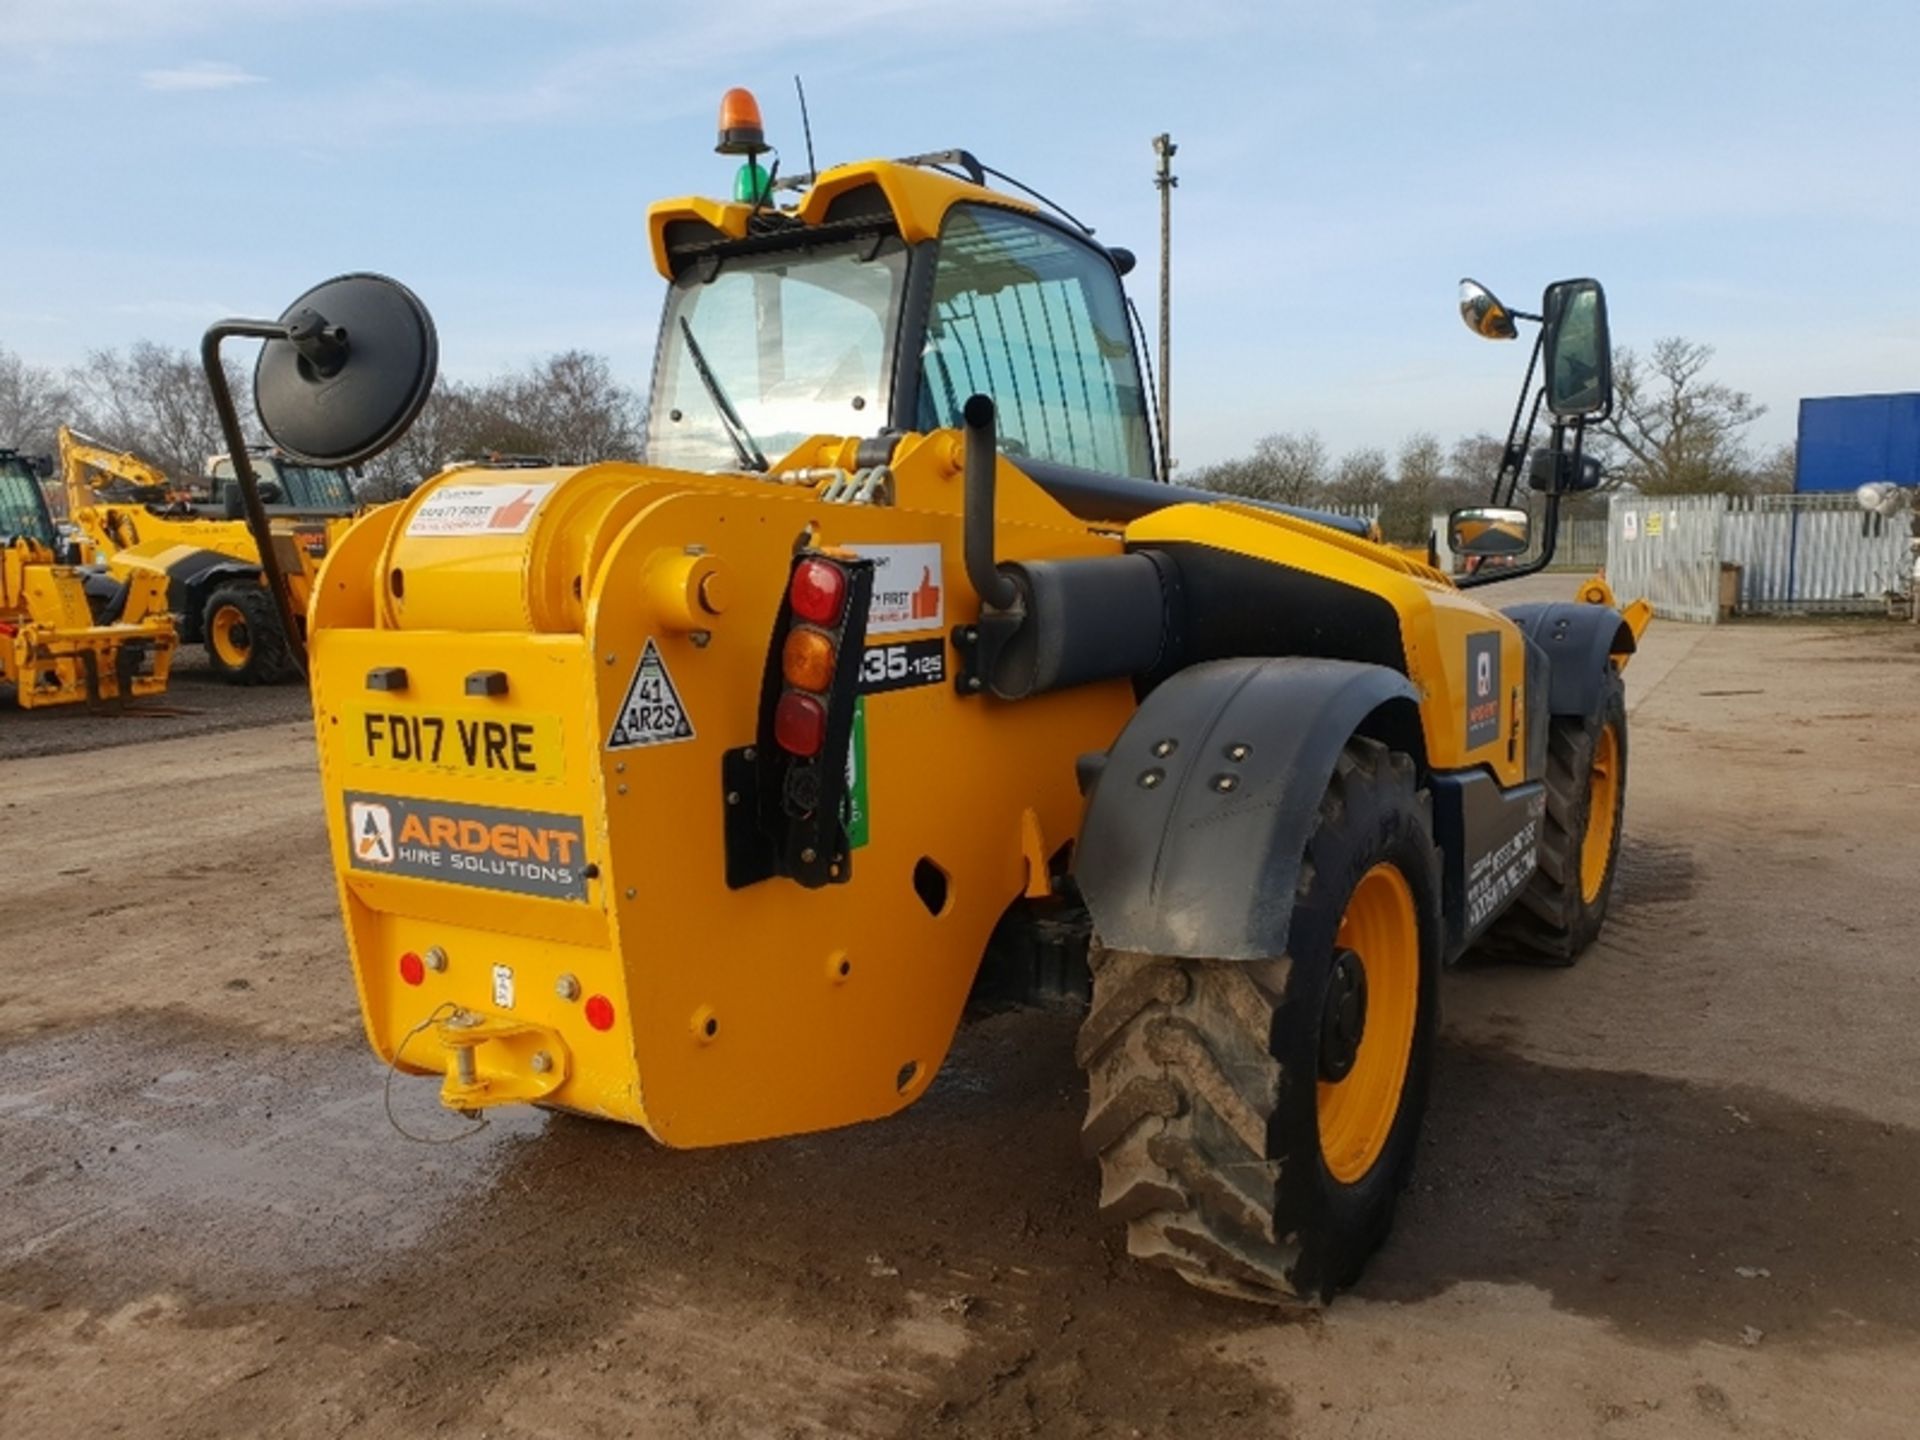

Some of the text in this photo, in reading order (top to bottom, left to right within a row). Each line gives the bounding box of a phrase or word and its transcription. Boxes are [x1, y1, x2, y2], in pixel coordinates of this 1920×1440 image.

[640, 678, 662, 704] 41
[365, 713, 537, 772] FD17 VRE
[400, 813, 579, 865] ARDENT
[398, 847, 573, 885] HIRE SOLUTIONS
